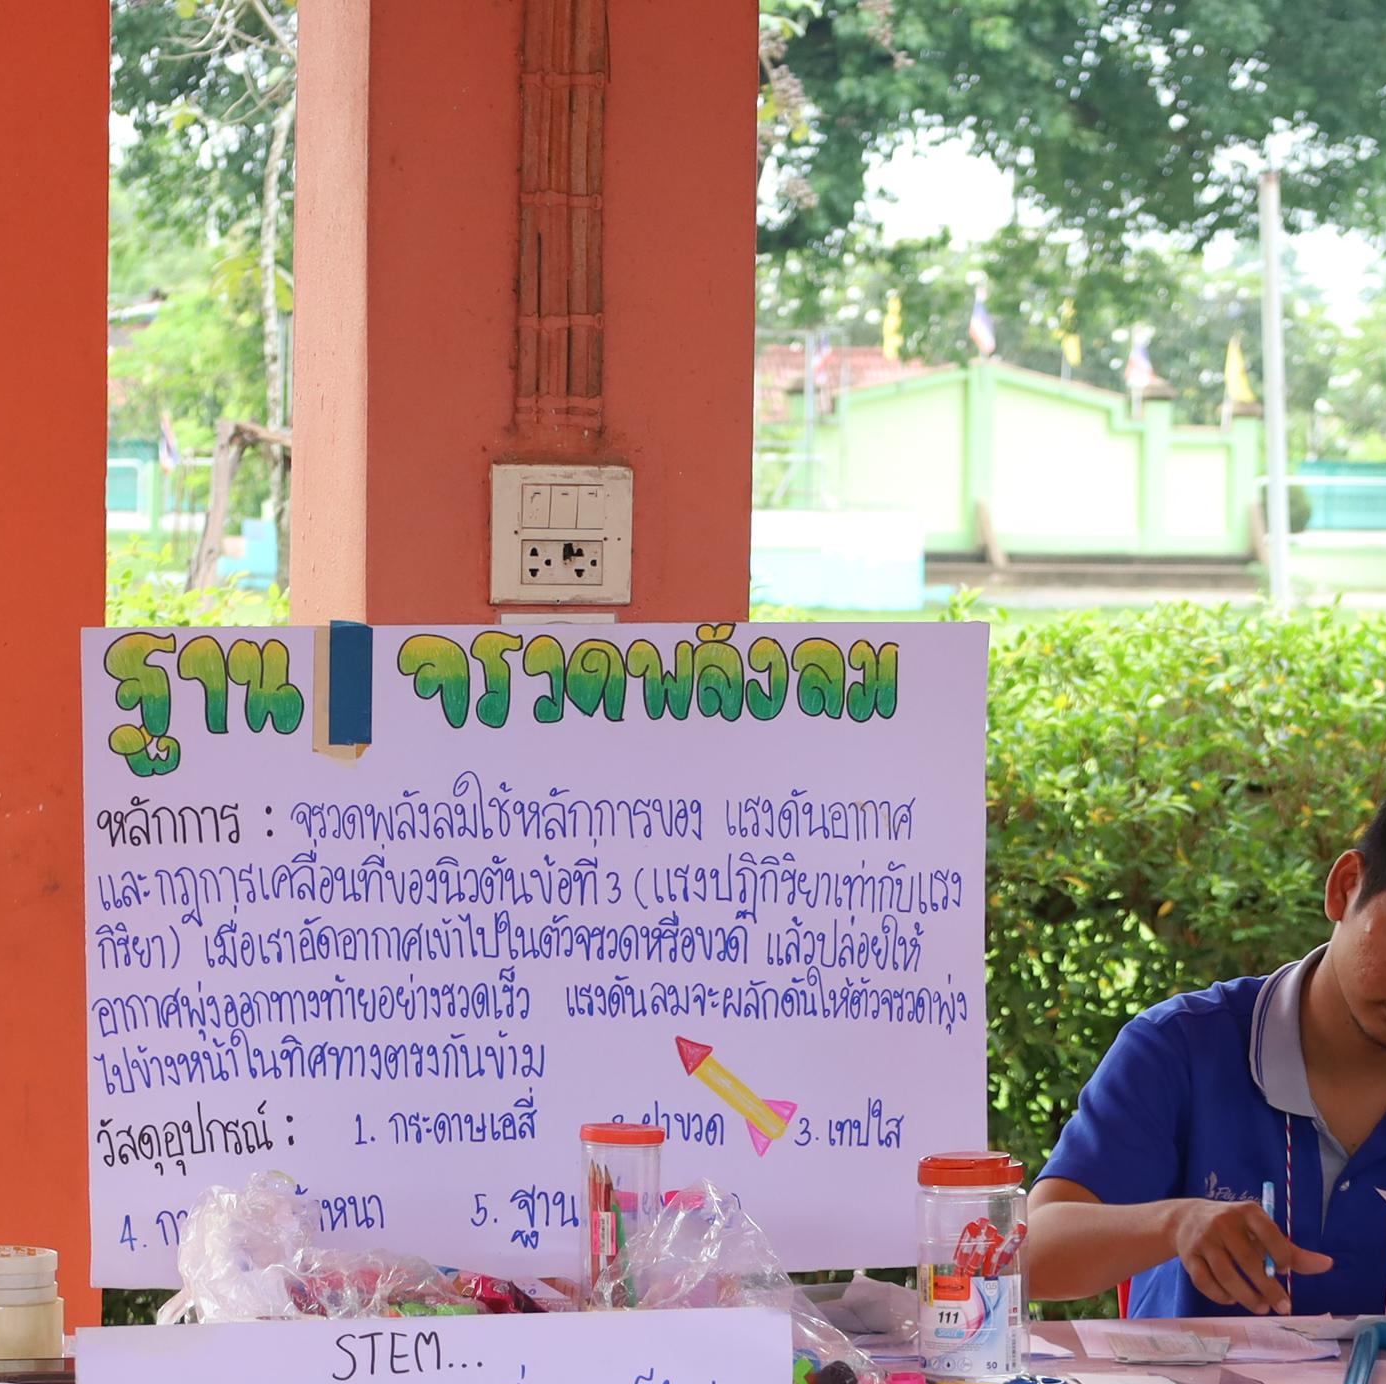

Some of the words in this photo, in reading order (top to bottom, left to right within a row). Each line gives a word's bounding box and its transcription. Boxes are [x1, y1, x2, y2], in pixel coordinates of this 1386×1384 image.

[104, 632, 305, 778] ฐาน
[396, 622, 901, 730] จรวดพลังลม
[96, 796, 242, 848] หลักการ
[725, 788, 916, 841] แรงดันอากาศ
[96, 1100, 274, 1177] วัสดุอุปกรณ์
[389, 1087, 538, 1144] กระดาษเอสี่
[827, 1098, 904, 1149] เทปใส
[938, 1311, 960, 1324] 111
[986, 1361, 998, 1370] 50
